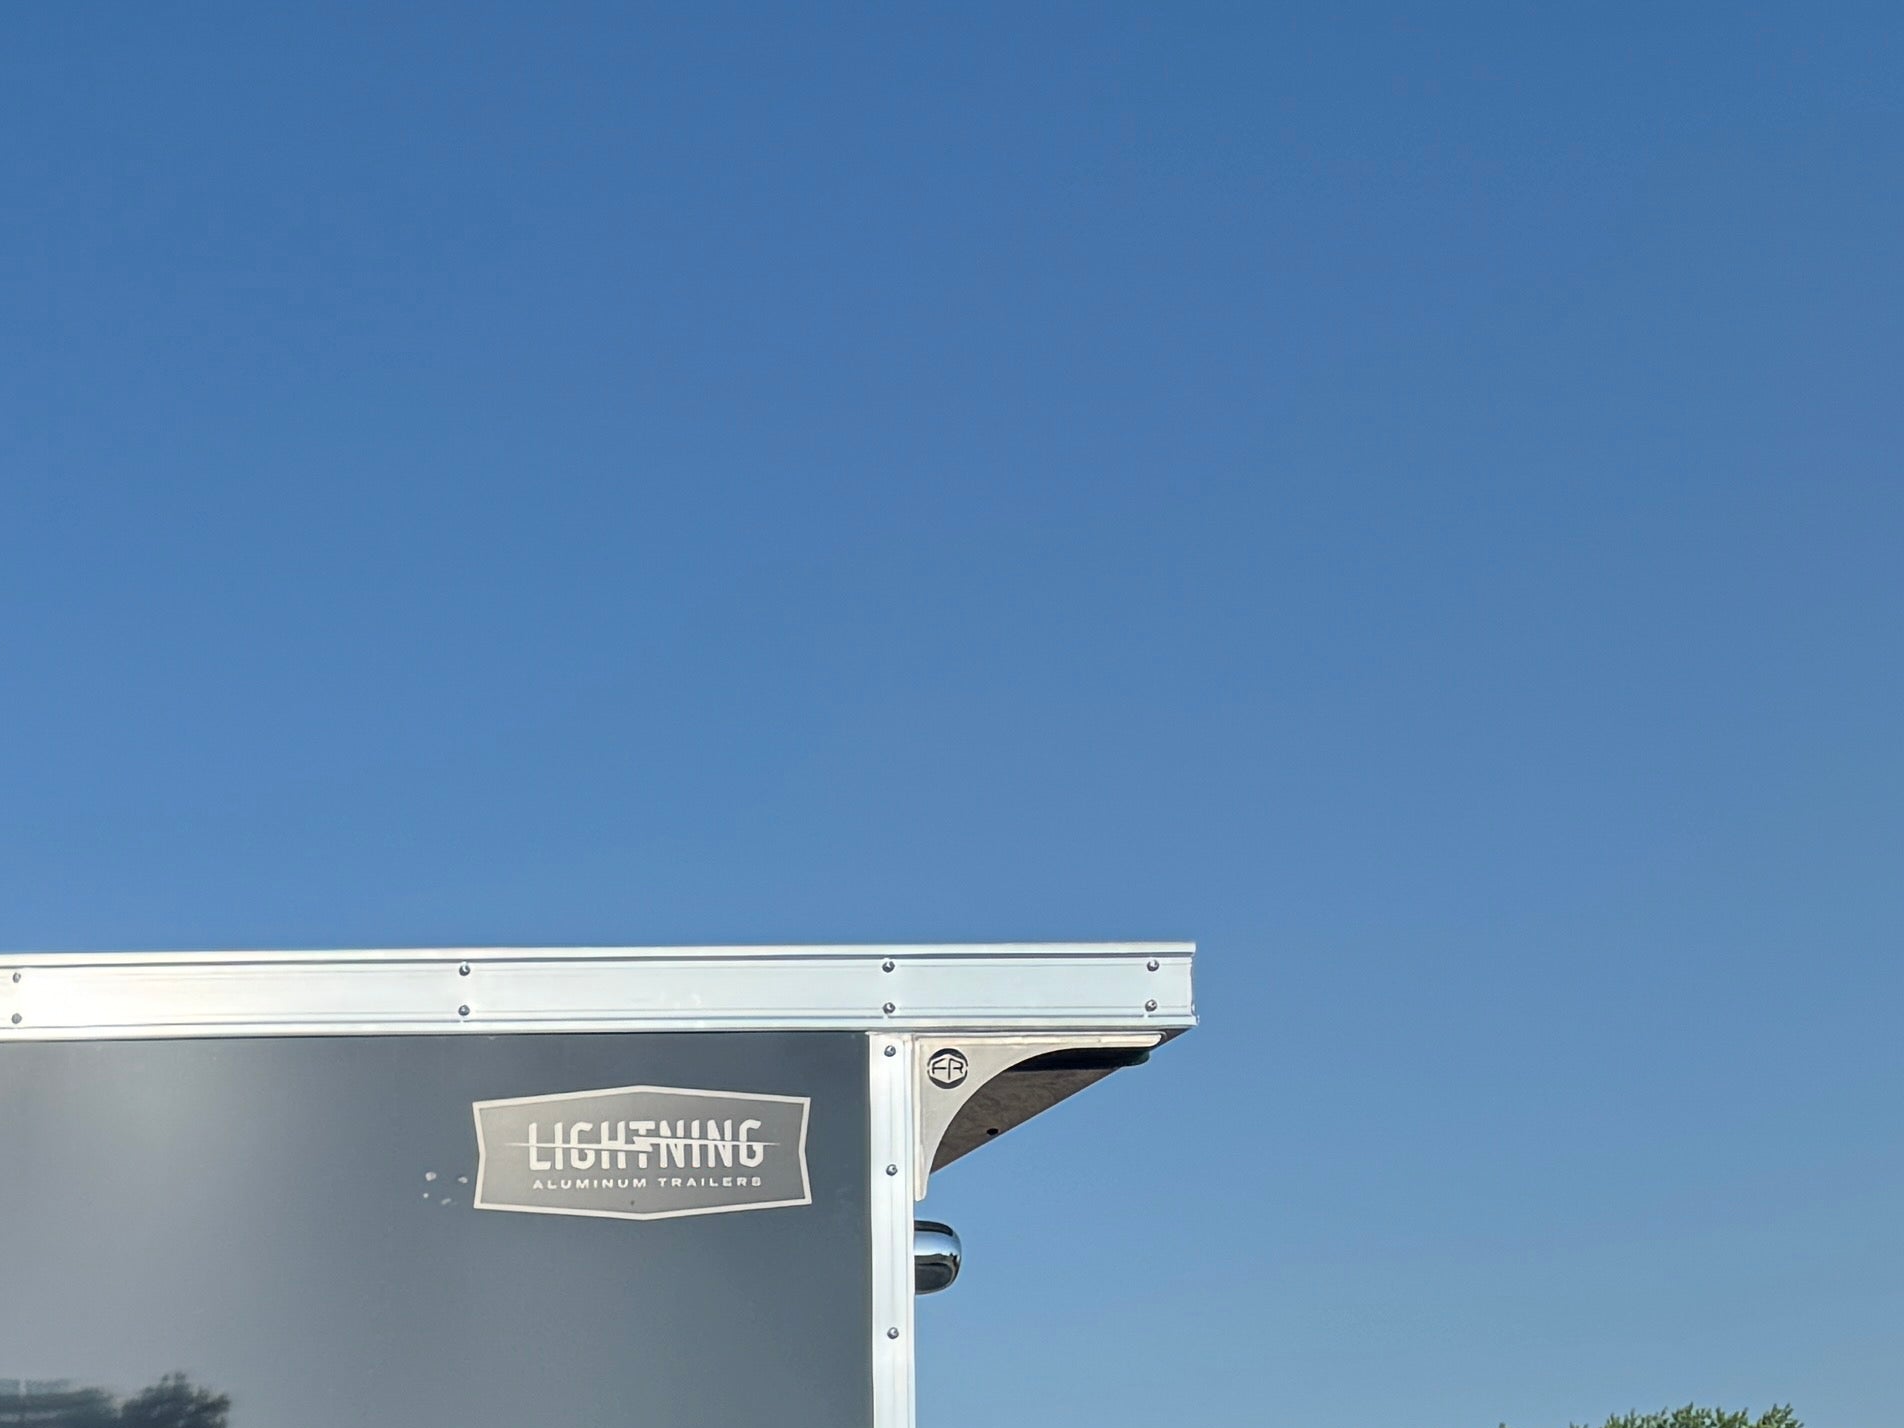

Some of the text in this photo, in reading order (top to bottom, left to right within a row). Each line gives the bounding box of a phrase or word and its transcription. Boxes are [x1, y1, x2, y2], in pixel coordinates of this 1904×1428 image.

[528, 1119, 765, 1171] LIGHTNING
[533, 1176, 762, 1190] ALUMINUM TRAILERS
